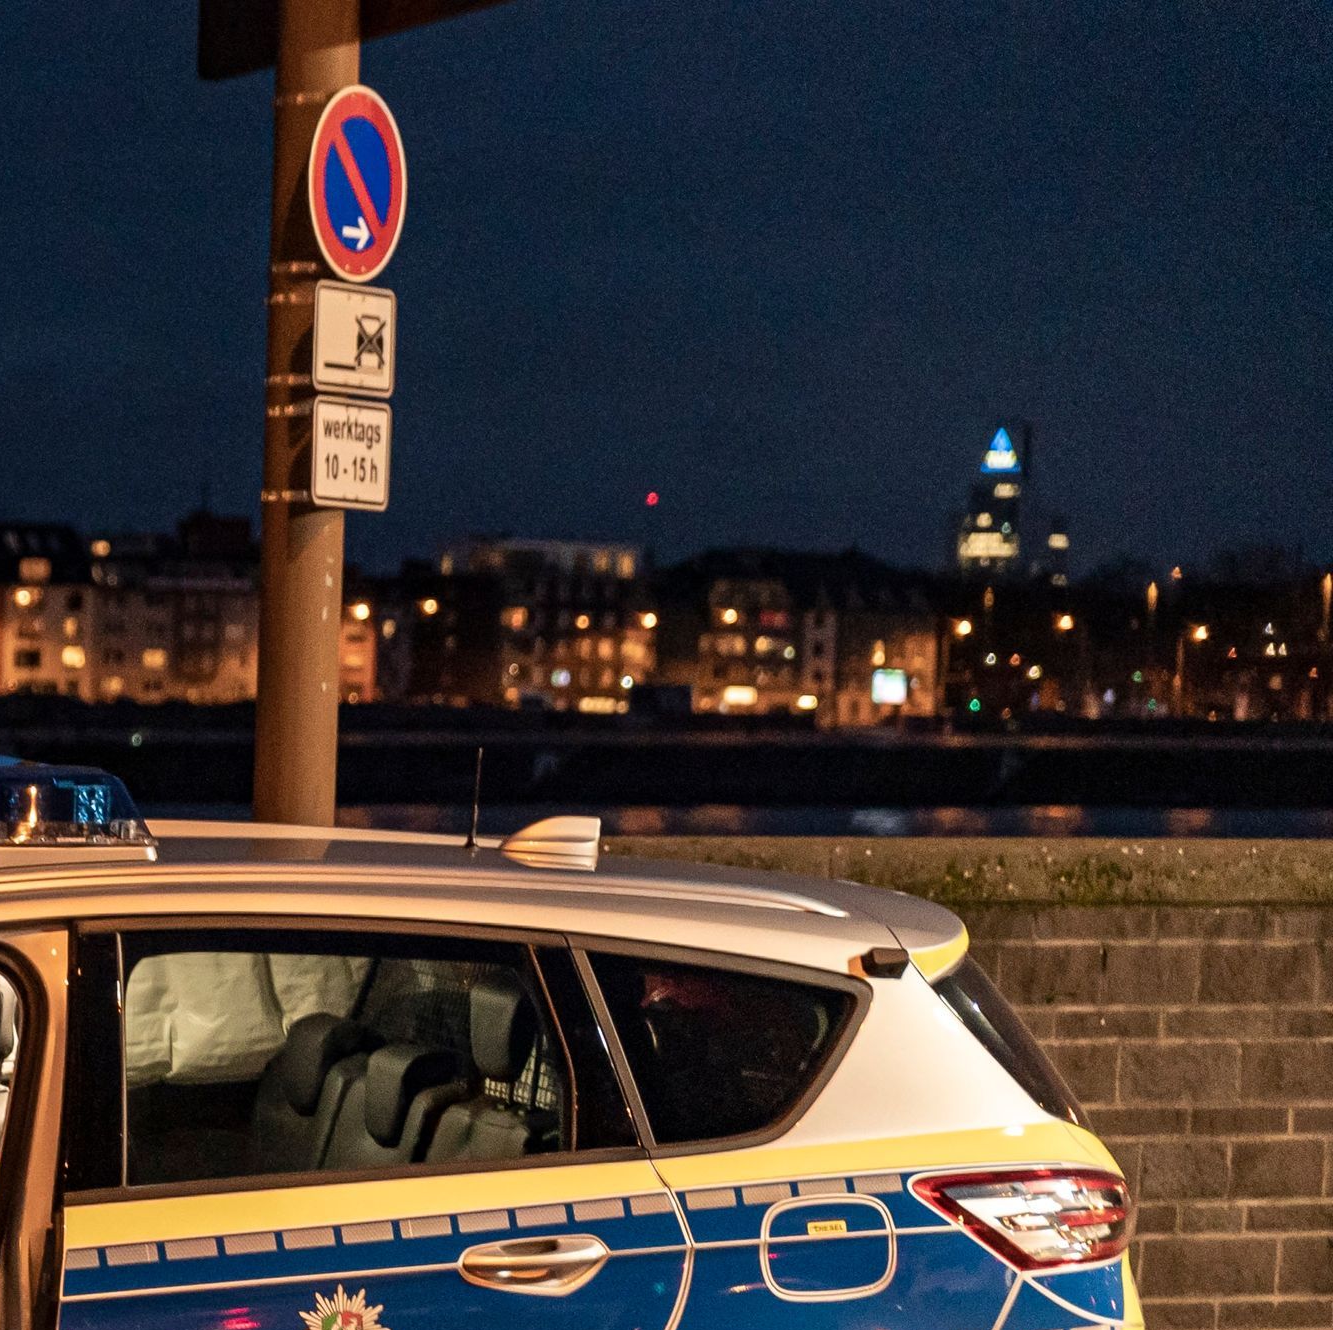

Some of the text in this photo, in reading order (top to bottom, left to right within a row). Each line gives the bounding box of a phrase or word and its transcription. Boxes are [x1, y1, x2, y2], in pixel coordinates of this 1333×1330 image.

[323, 416, 381, 450] werktags
[325, 453, 339, 480] 10
[353, 456, 366, 482] 15
[370, 458, 378, 484] h
